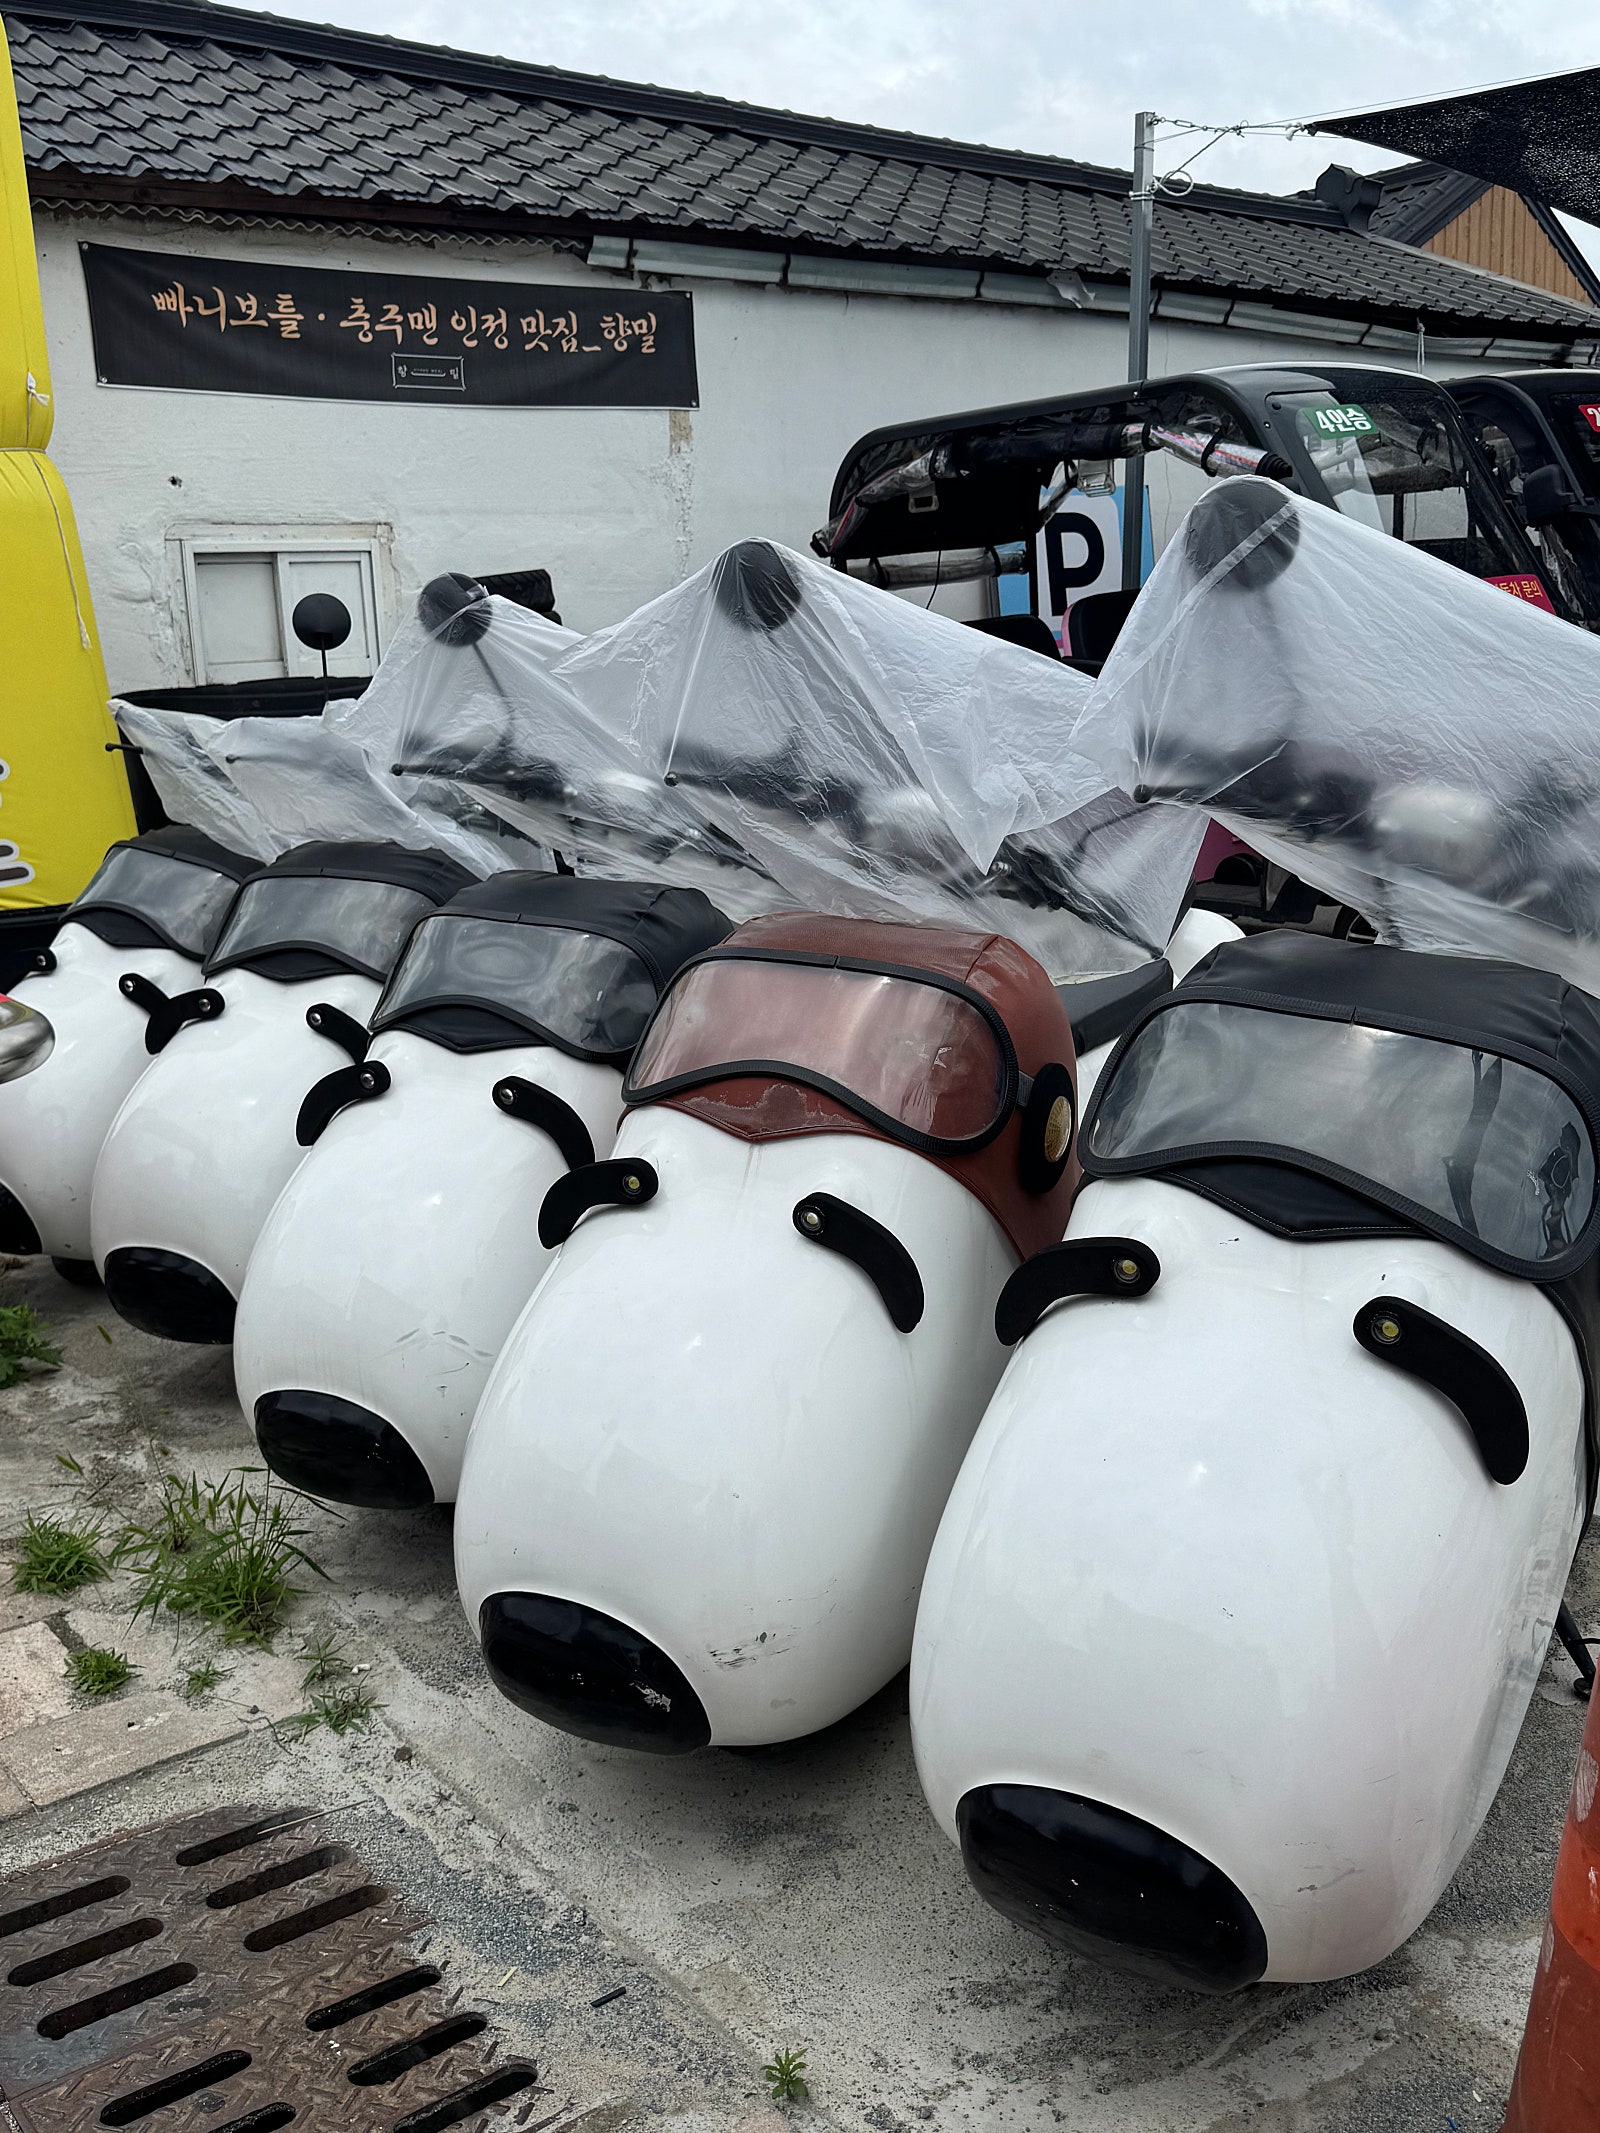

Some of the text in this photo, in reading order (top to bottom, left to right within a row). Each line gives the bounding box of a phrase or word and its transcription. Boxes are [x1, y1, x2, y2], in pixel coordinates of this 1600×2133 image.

[151, 281, 305, 339] 빠니보틀
[339, 297, 439, 345] 충주맨
[450, 304, 509, 350] 인정
[1315, 408, 1372, 432] 4인승
[1044, 512, 1105, 617] P
[1521, 580, 1543, 598] 문의
